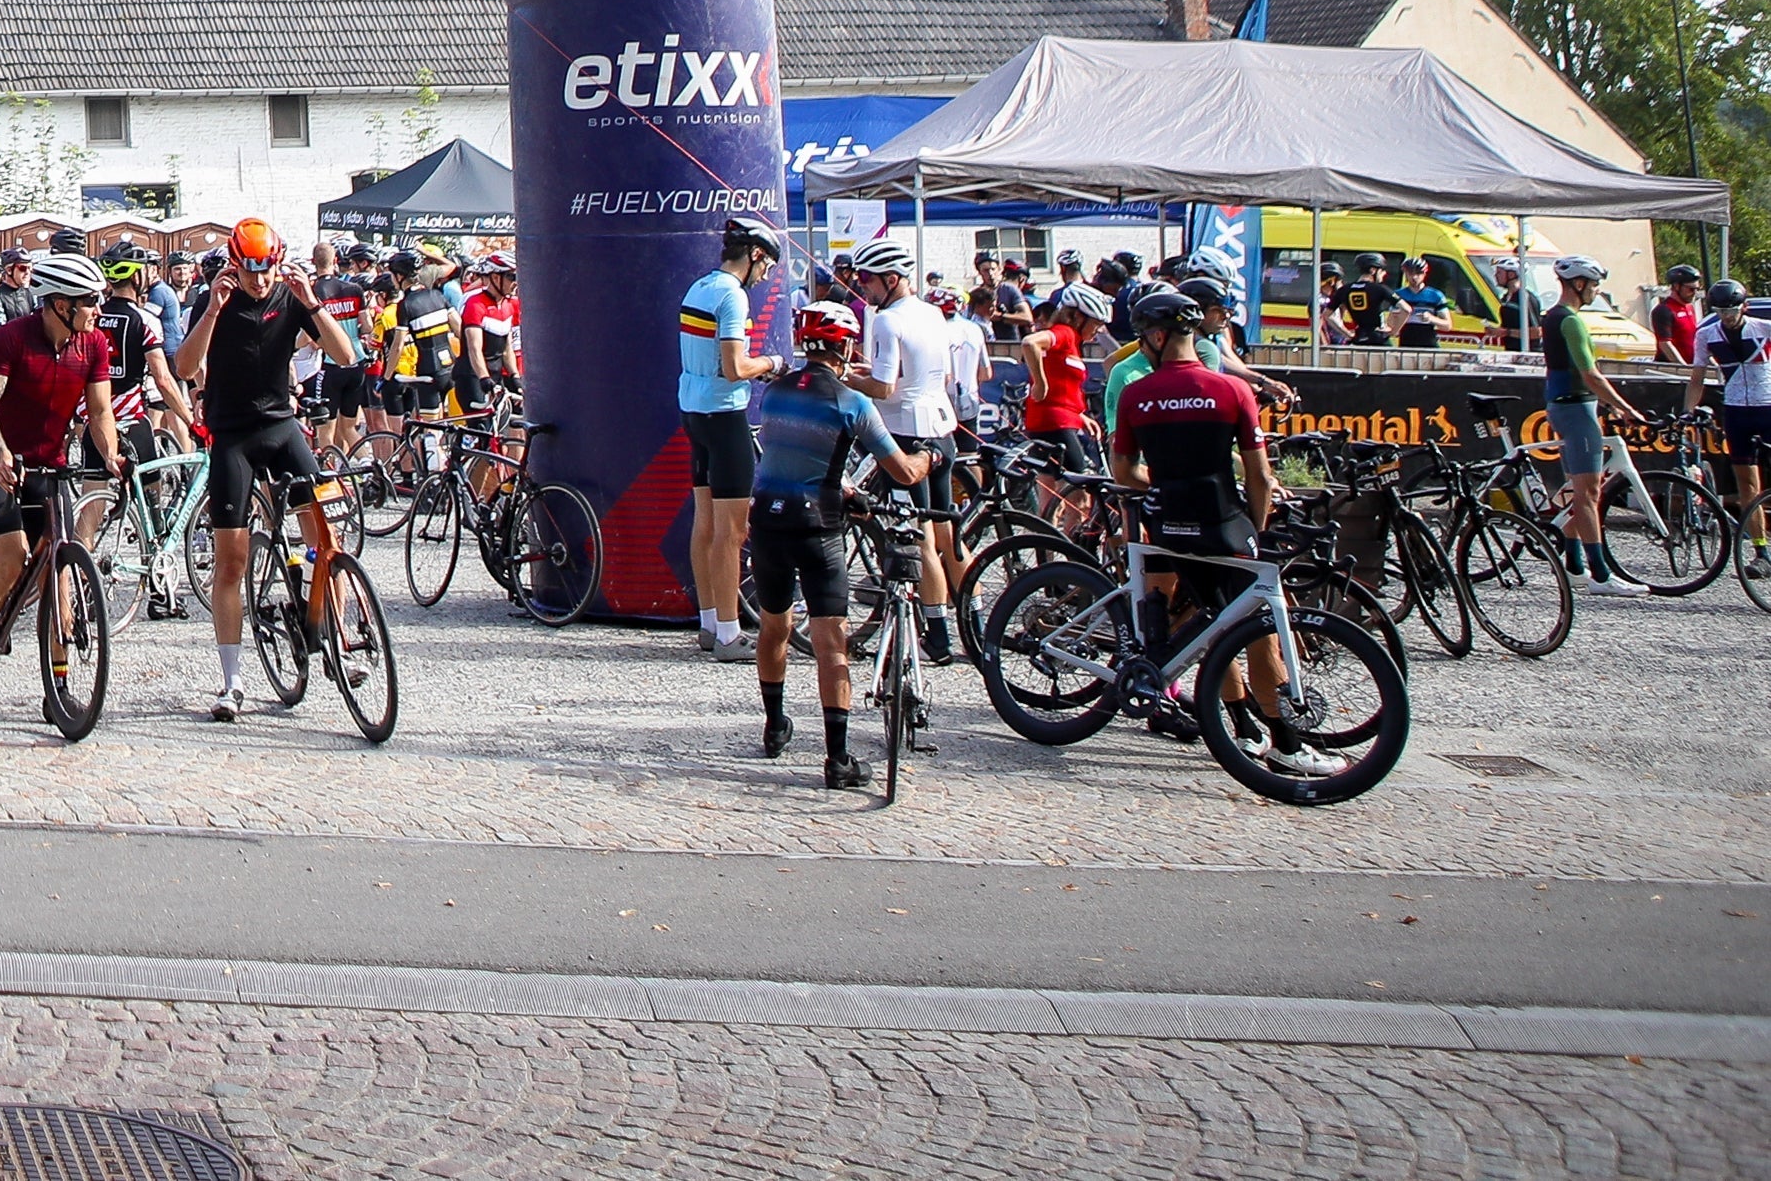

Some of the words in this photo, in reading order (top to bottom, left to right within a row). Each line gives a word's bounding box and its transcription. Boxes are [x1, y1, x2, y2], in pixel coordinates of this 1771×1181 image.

[563, 34, 761, 110] etixx
[587, 115, 664, 128] sports
[676, 113, 761, 125] nutrition
[570, 188, 779, 215] #FUELYOURGOAL
[324, 300, 356, 317] ELVAUX
[98, 317, 119, 329] Café
